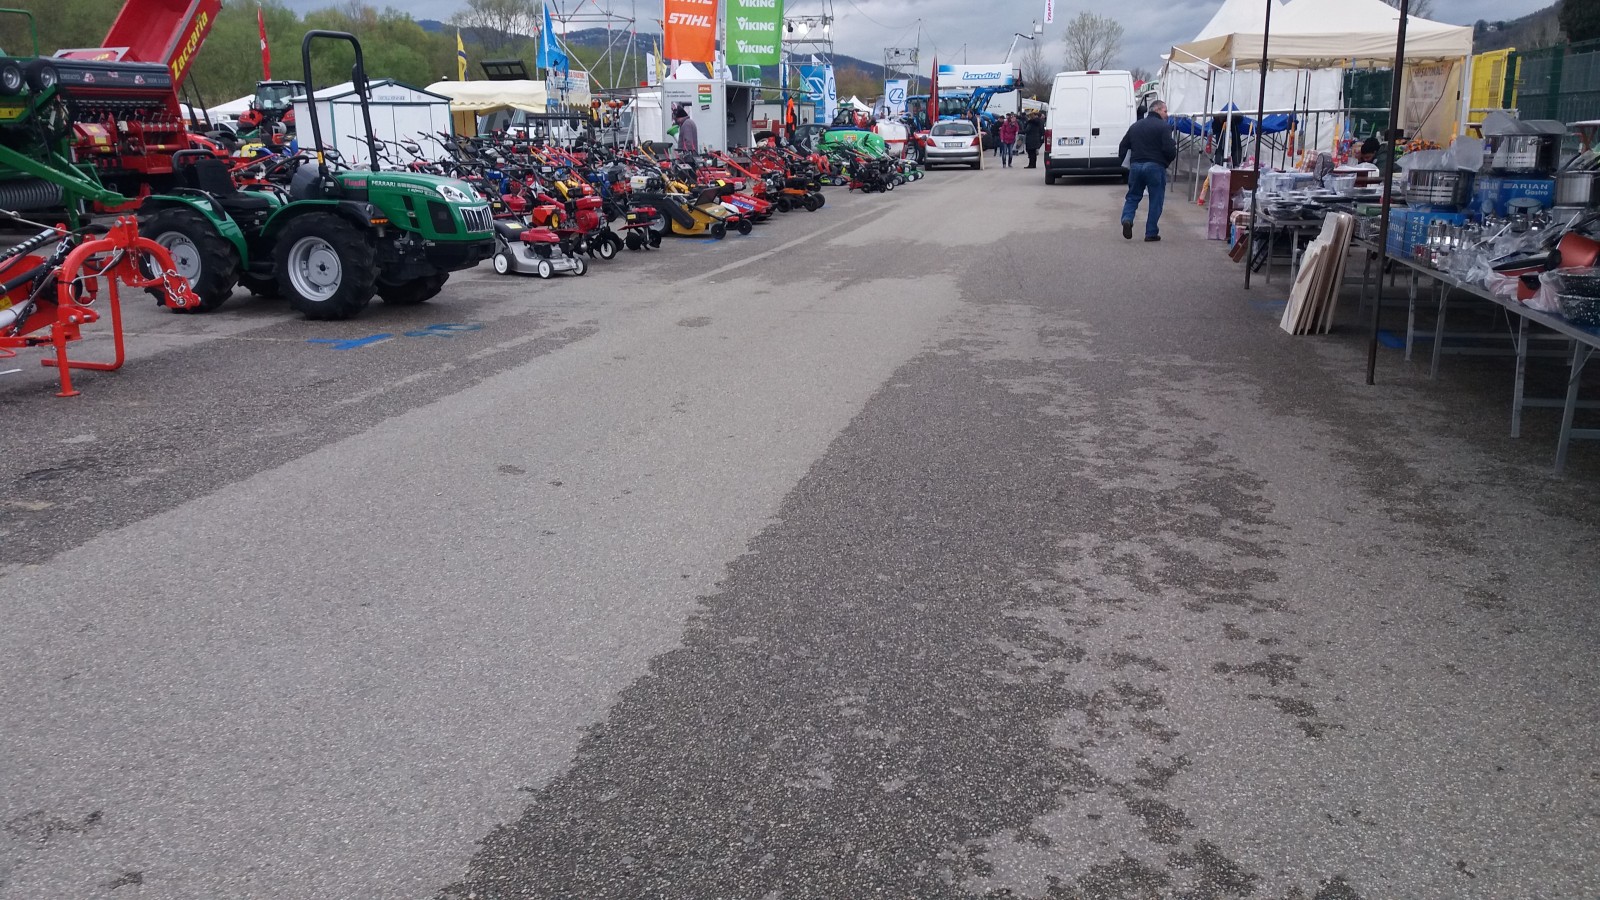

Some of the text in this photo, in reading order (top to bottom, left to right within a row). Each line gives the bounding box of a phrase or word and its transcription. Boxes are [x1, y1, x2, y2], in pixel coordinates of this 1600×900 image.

[668, 13, 711, 28] STIHL
[737, 18, 775, 31] VIKING
[172, 11, 208, 81] Zaccaria
[737, 41, 775, 54] VIKING
[962, 71, 1001, 80] Landini
[1524, 188, 1549, 196] Gastro
